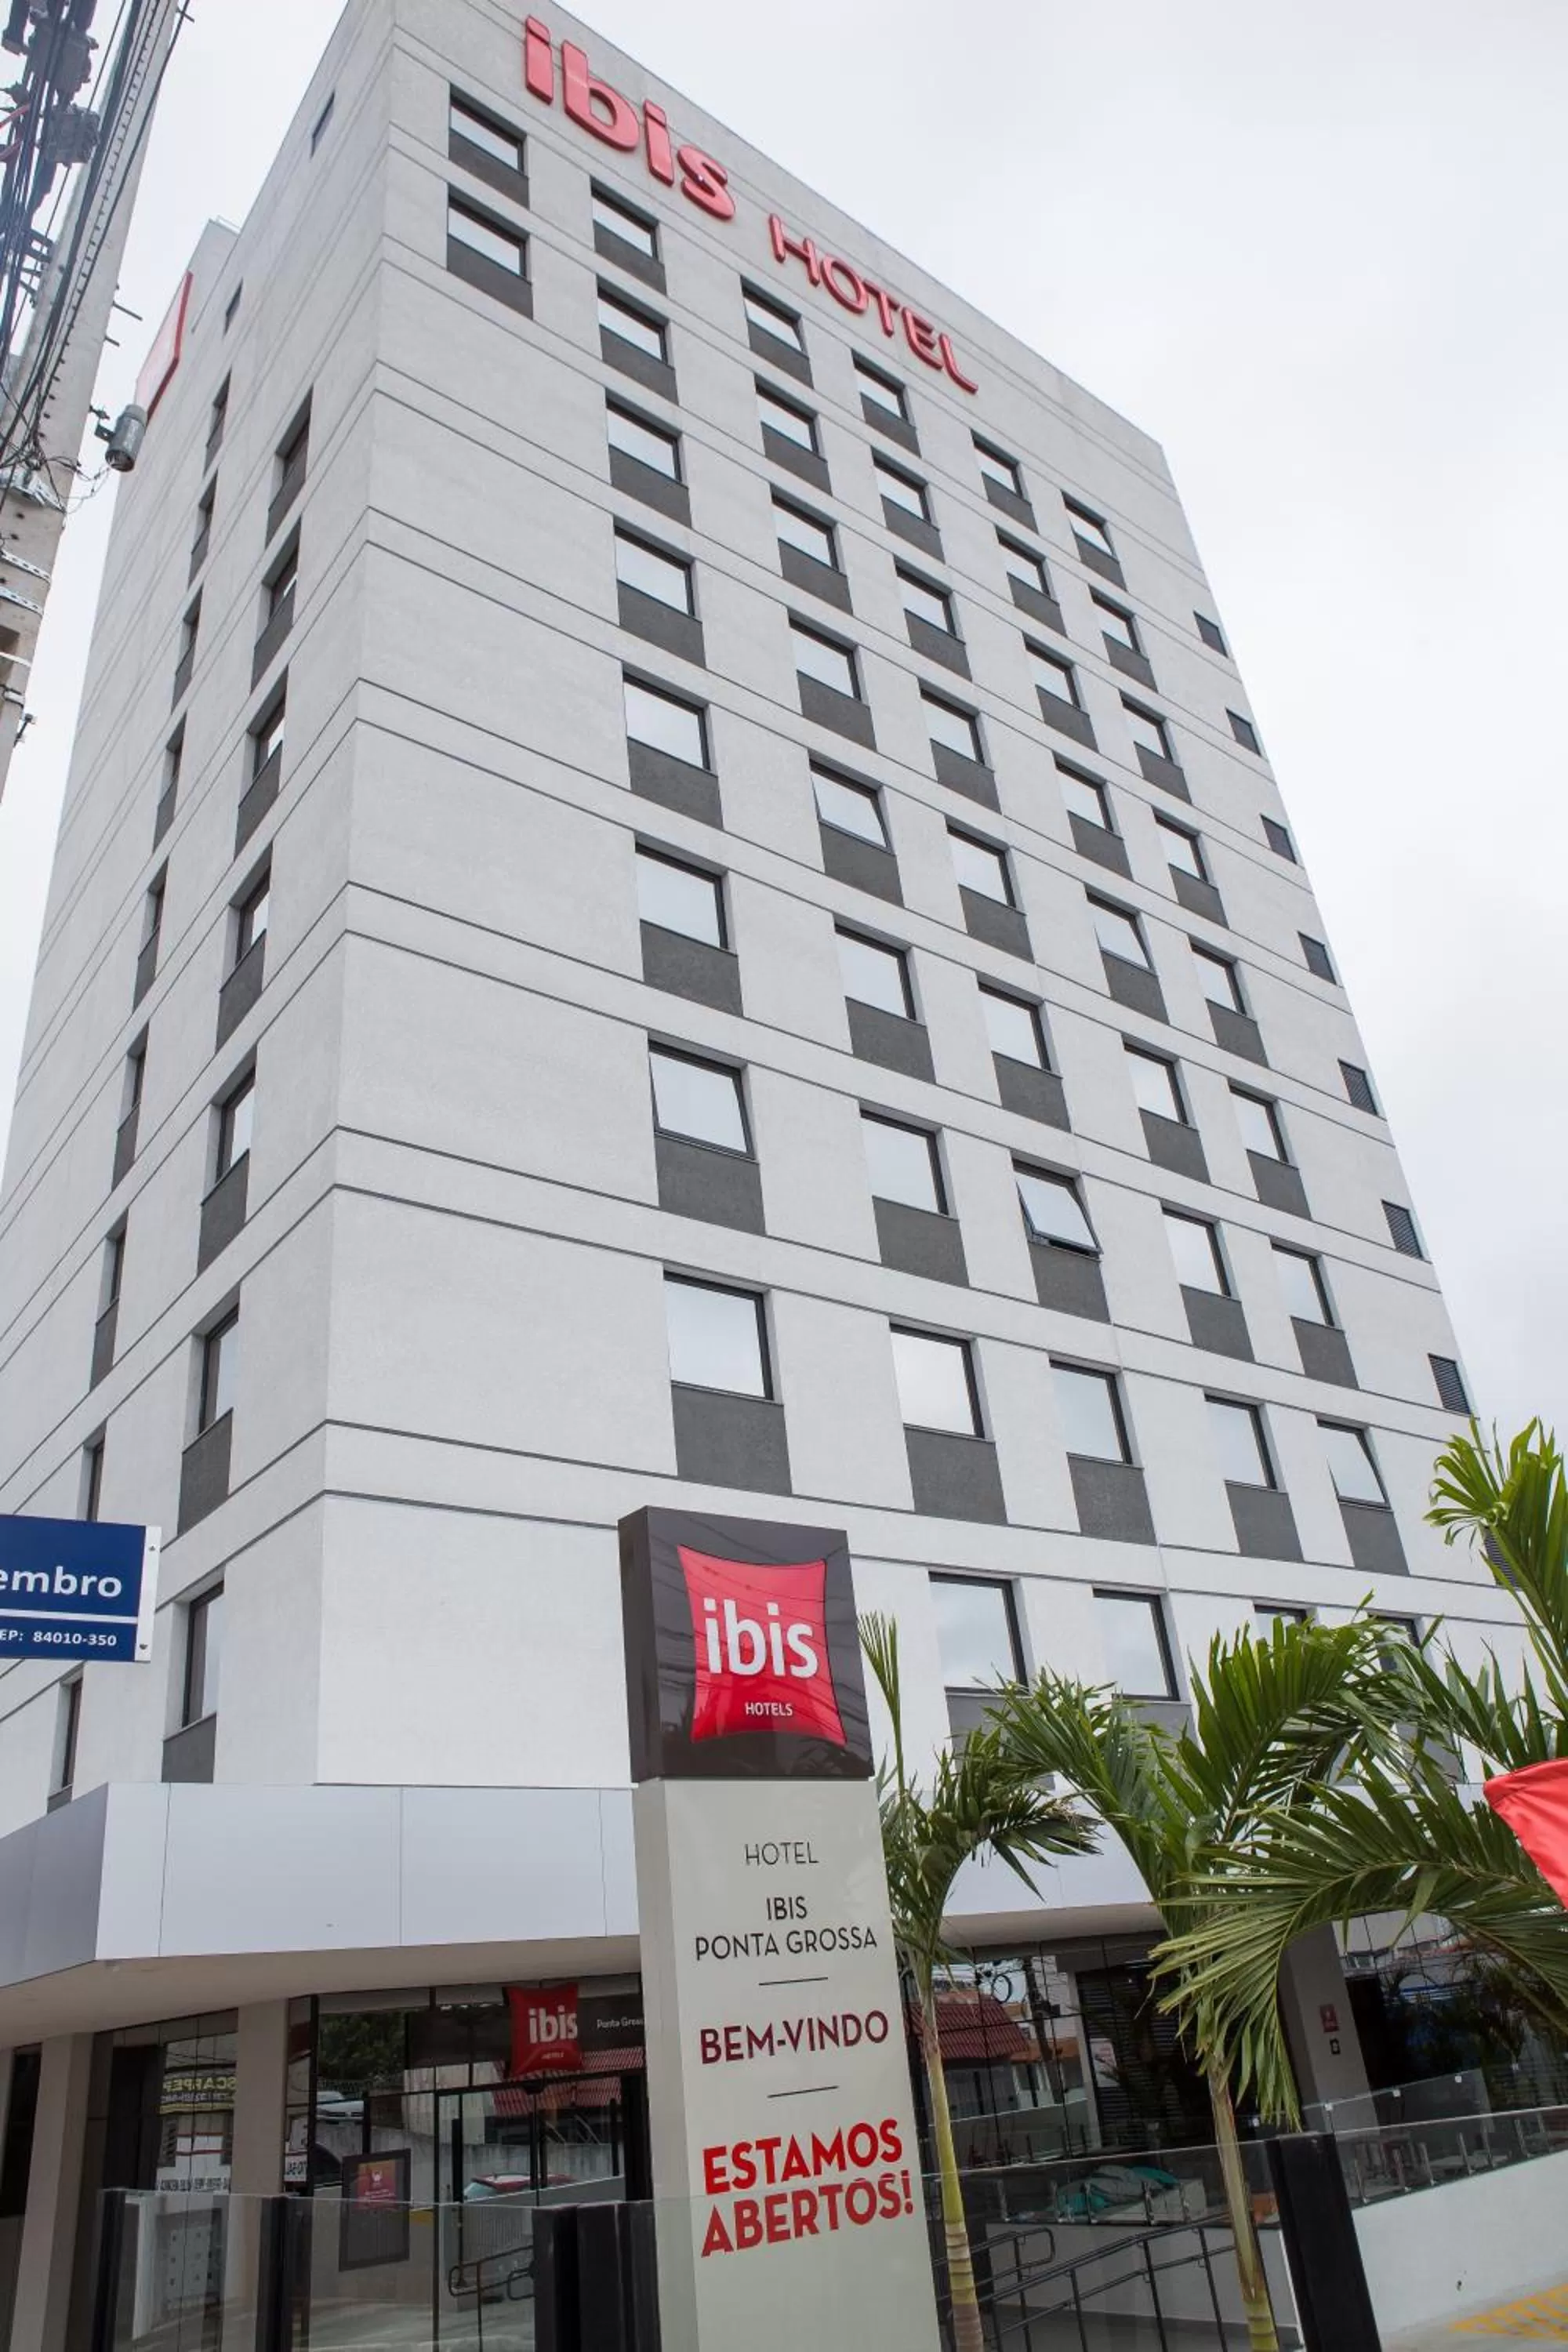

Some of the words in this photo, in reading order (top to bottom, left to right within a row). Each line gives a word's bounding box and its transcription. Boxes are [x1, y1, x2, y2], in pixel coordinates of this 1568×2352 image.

[524, 15, 735, 220] ibis
[769, 213, 978, 394] HOTEL
[33, 1631, 118, 1646] 84010-350
[703, 1596, 818, 1679] ibis
[746, 1702, 793, 1717] HOTELS
[745, 1841, 819, 1866] HOTEL
[766, 1895, 808, 1921] IBIS
[695, 1932, 779, 1961] PONTA
[786, 1926, 877, 1954] GROSSA
[528, 2005, 578, 2044] ibis
[700, 2009, 889, 2064] BEM-VINDO
[702, 2118, 902, 2195] ESTAMOS
[701, 2169, 913, 2258] ABERTOS!
